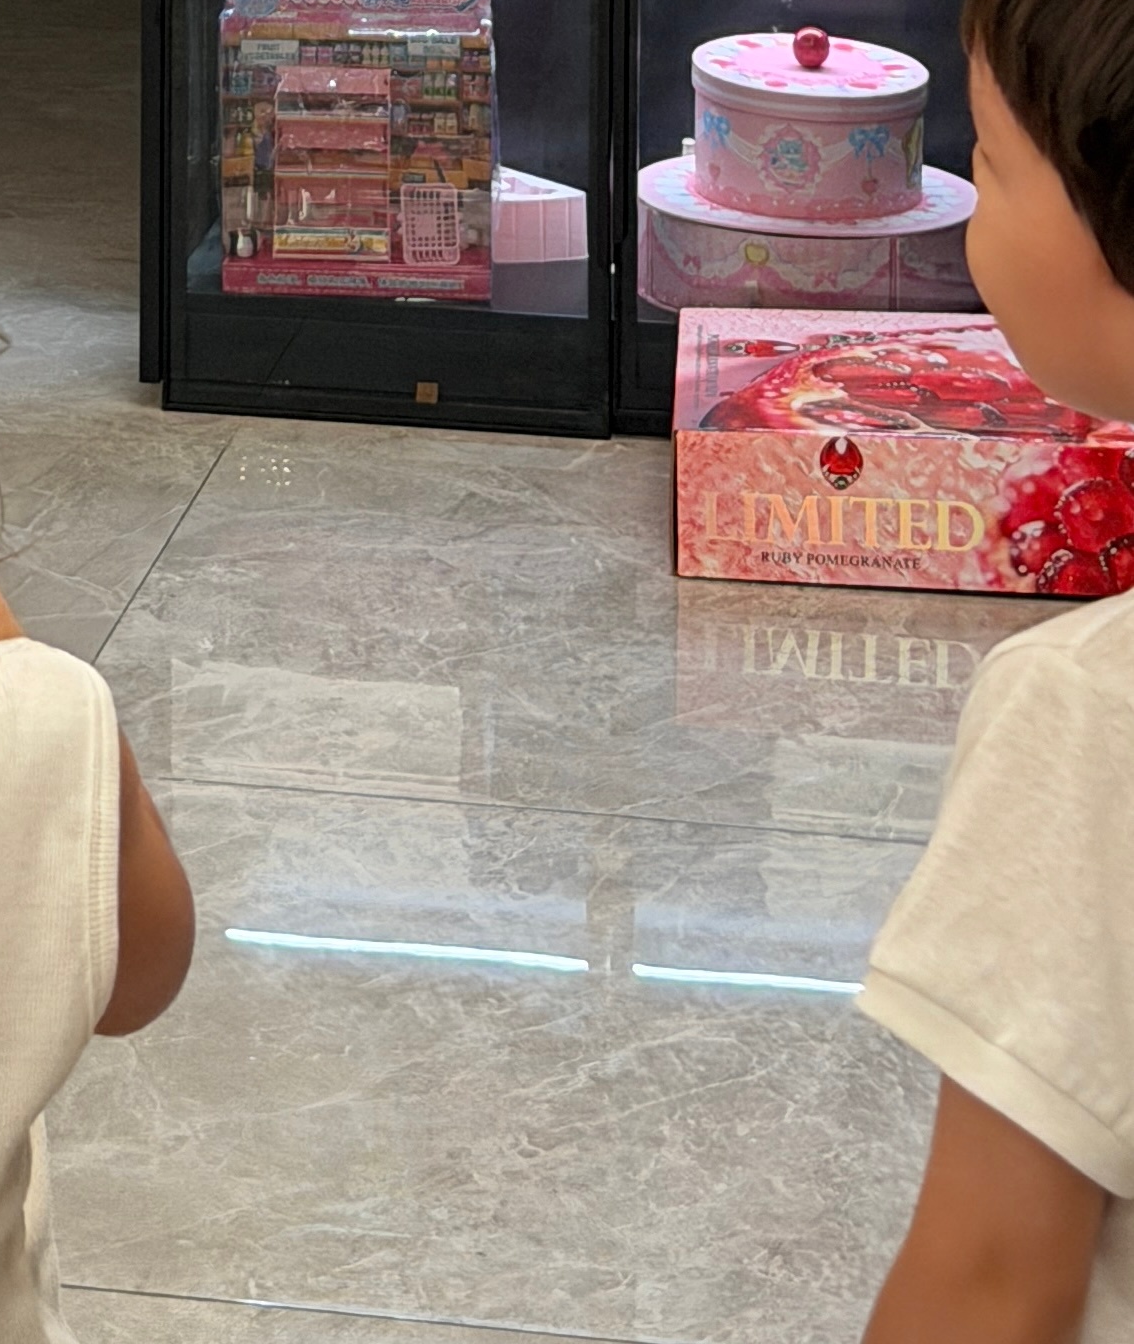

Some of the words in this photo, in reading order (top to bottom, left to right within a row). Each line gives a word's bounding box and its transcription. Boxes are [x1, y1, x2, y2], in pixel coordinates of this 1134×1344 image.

[704, 491, 985, 552] LIMITED
[761, 551, 803, 564] RUBY
[806, 552, 922, 570] POMEGRANATE
